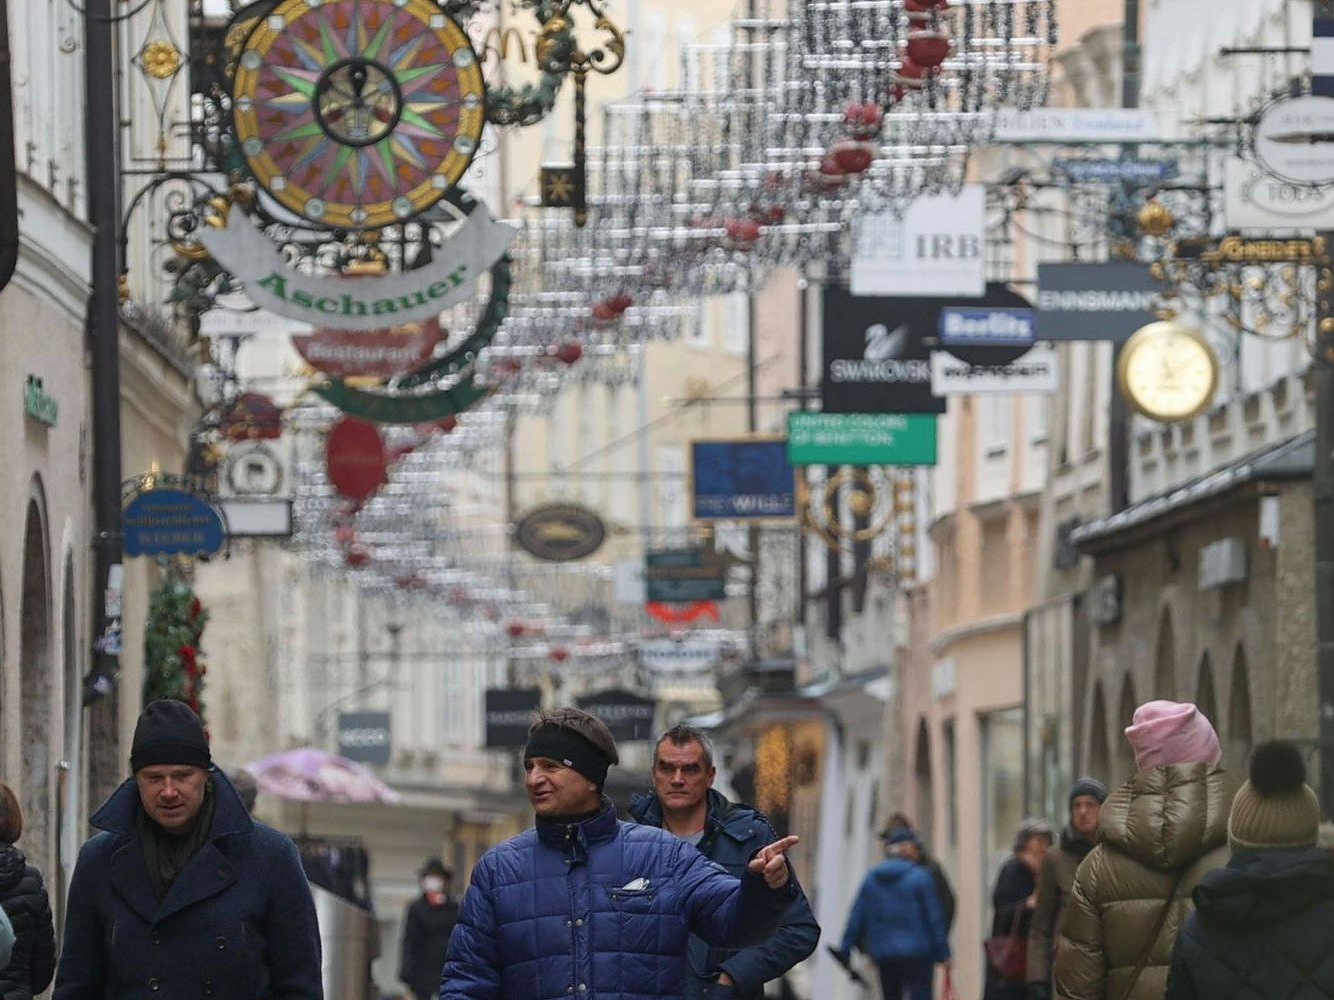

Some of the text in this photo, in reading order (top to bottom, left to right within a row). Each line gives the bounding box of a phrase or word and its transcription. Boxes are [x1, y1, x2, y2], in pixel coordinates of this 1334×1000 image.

[916, 233, 980, 259] IRB
[255, 264, 469, 317] Aschauer
[1038, 290, 1155, 312] ENNSMAN
[307, 342, 423, 362] Restaurant
[830, 359, 930, 383] SWAROVSK
